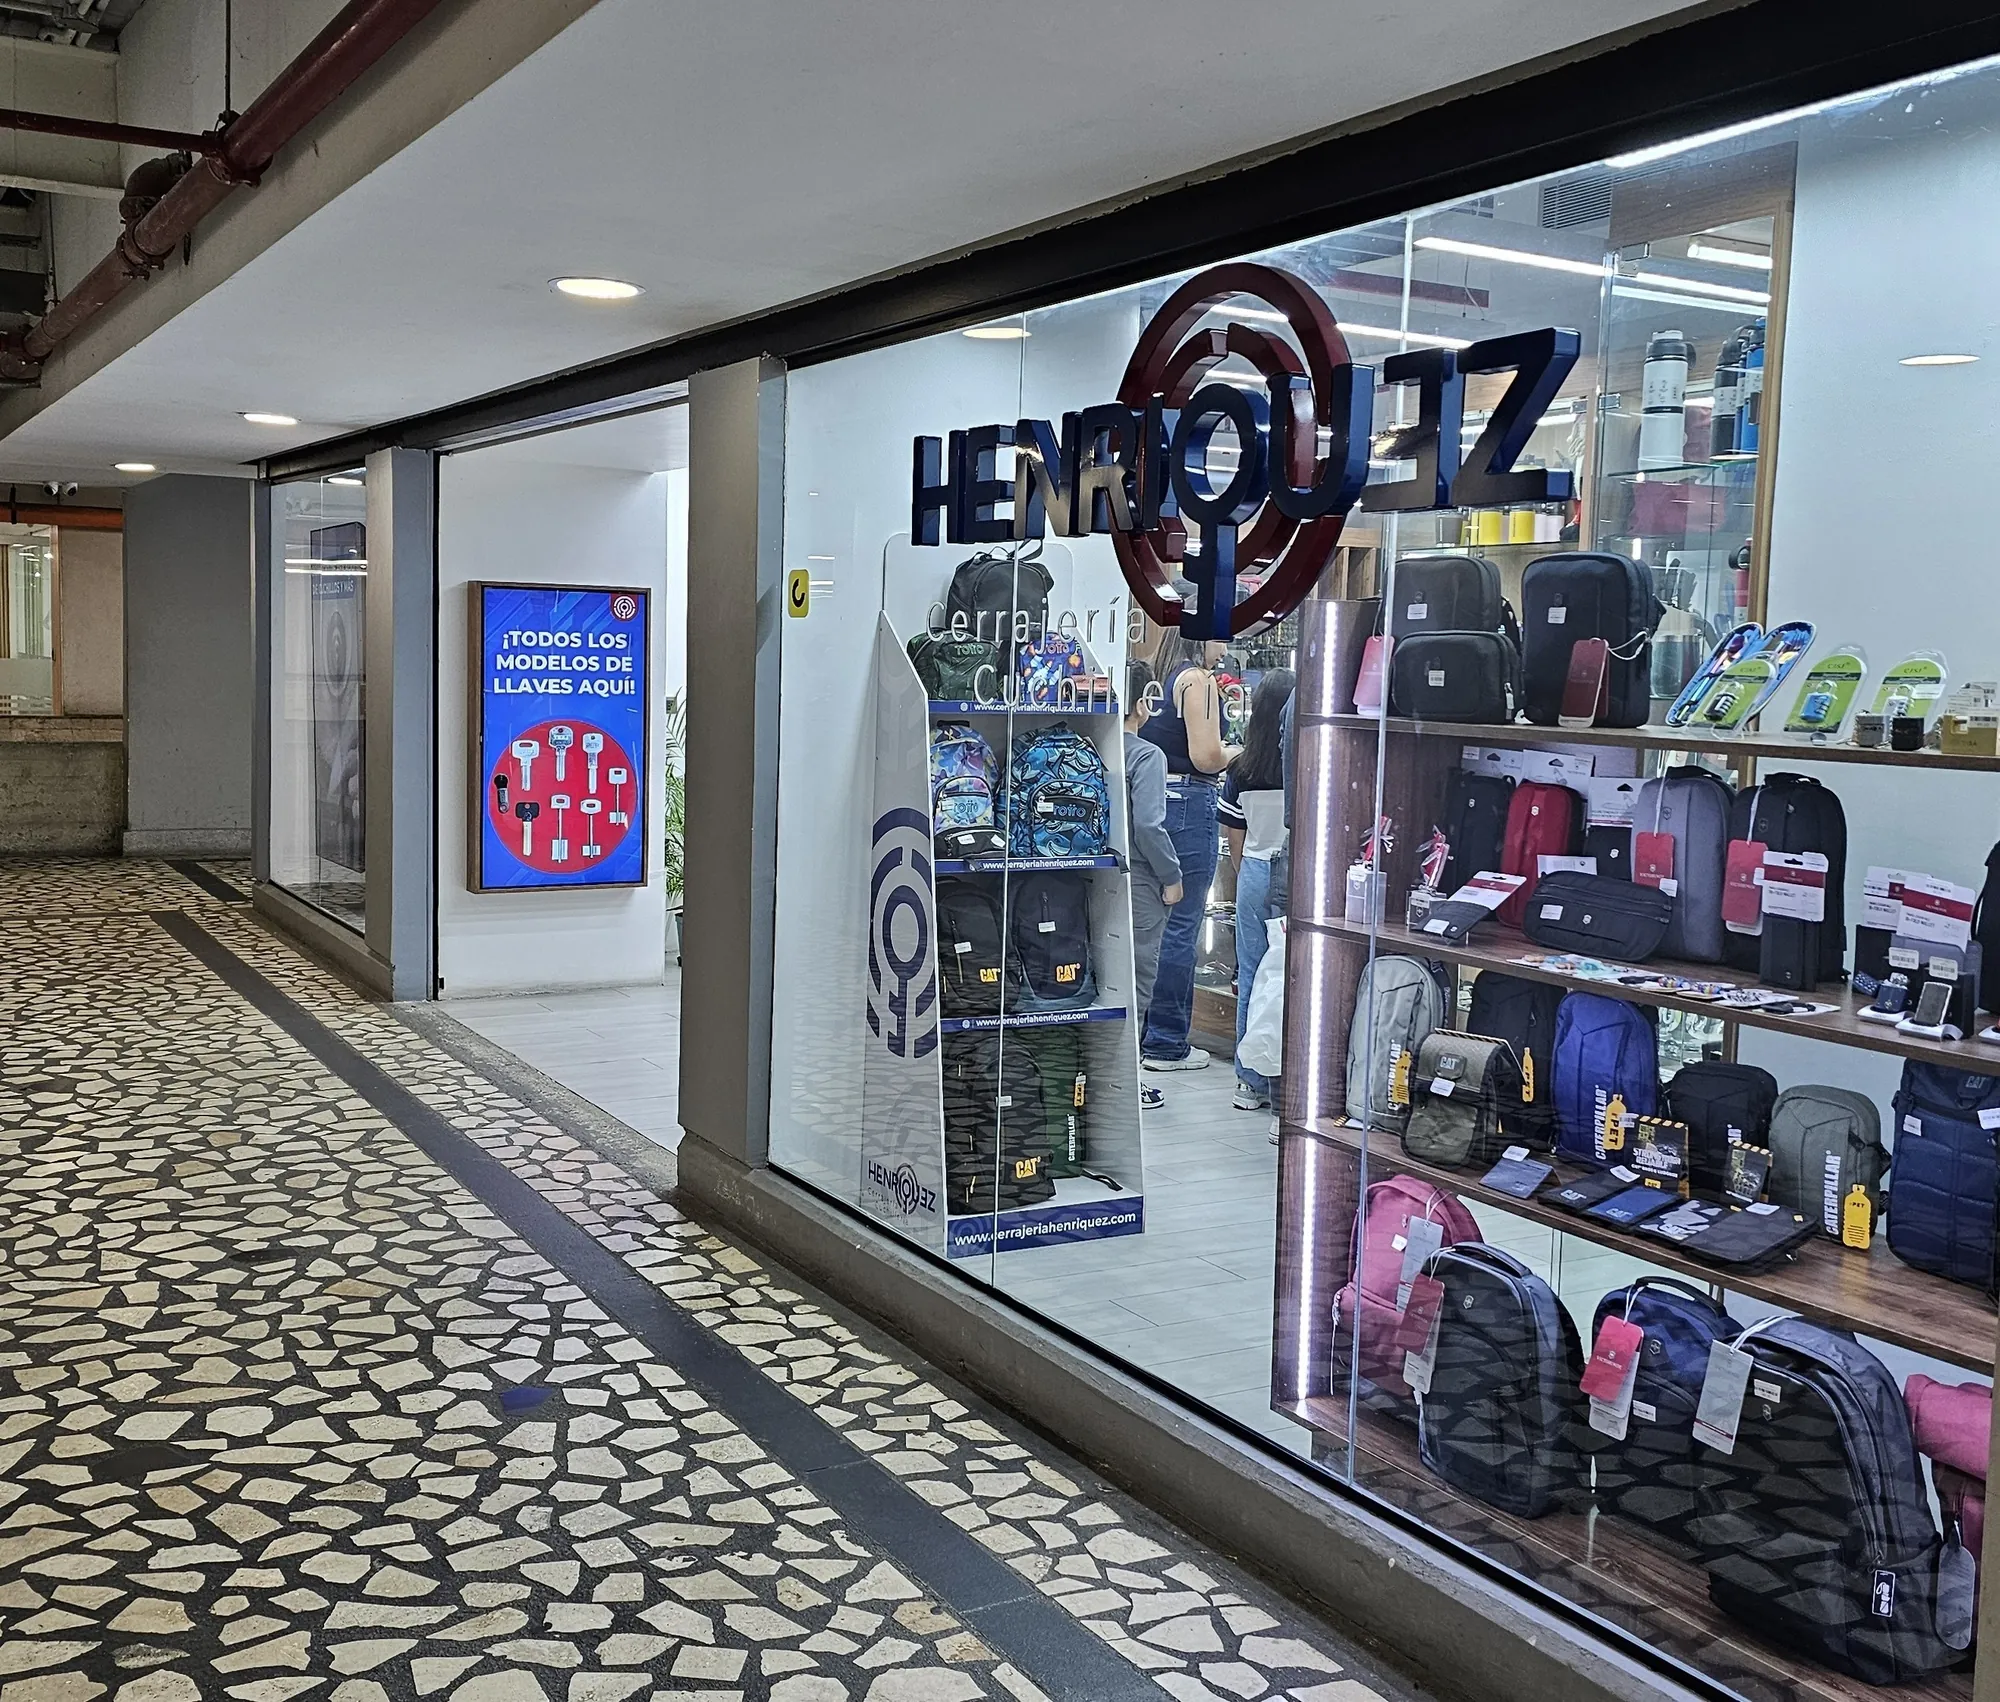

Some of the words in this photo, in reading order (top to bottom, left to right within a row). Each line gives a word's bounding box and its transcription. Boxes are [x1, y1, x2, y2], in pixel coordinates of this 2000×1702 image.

[925, 596, 1147, 655] Cerrajería
[502, 630, 582, 650] ¡TODOS
[588, 632, 628, 649] LOS
[496, 654, 600, 672] MODELOS
[606, 656, 633, 672] DE
[493, 677, 574, 694] LLAVES
[577, 675, 636, 698] AQUÍ!
[979, 967, 1001, 983] CAT
[1056, 962, 1081, 983] CAT
[1440, 1056, 1460, 1070] CAT
[1965, 1075, 1987, 1089] CAT
[1015, 1156, 1042, 1178] CAT
[1560, 1189, 1587, 1201] CAT
[1824, 1154, 1841, 1235] CATERPILLAR
[955, 1212, 1136, 1247] www.cerrajeriahenriquez.com
